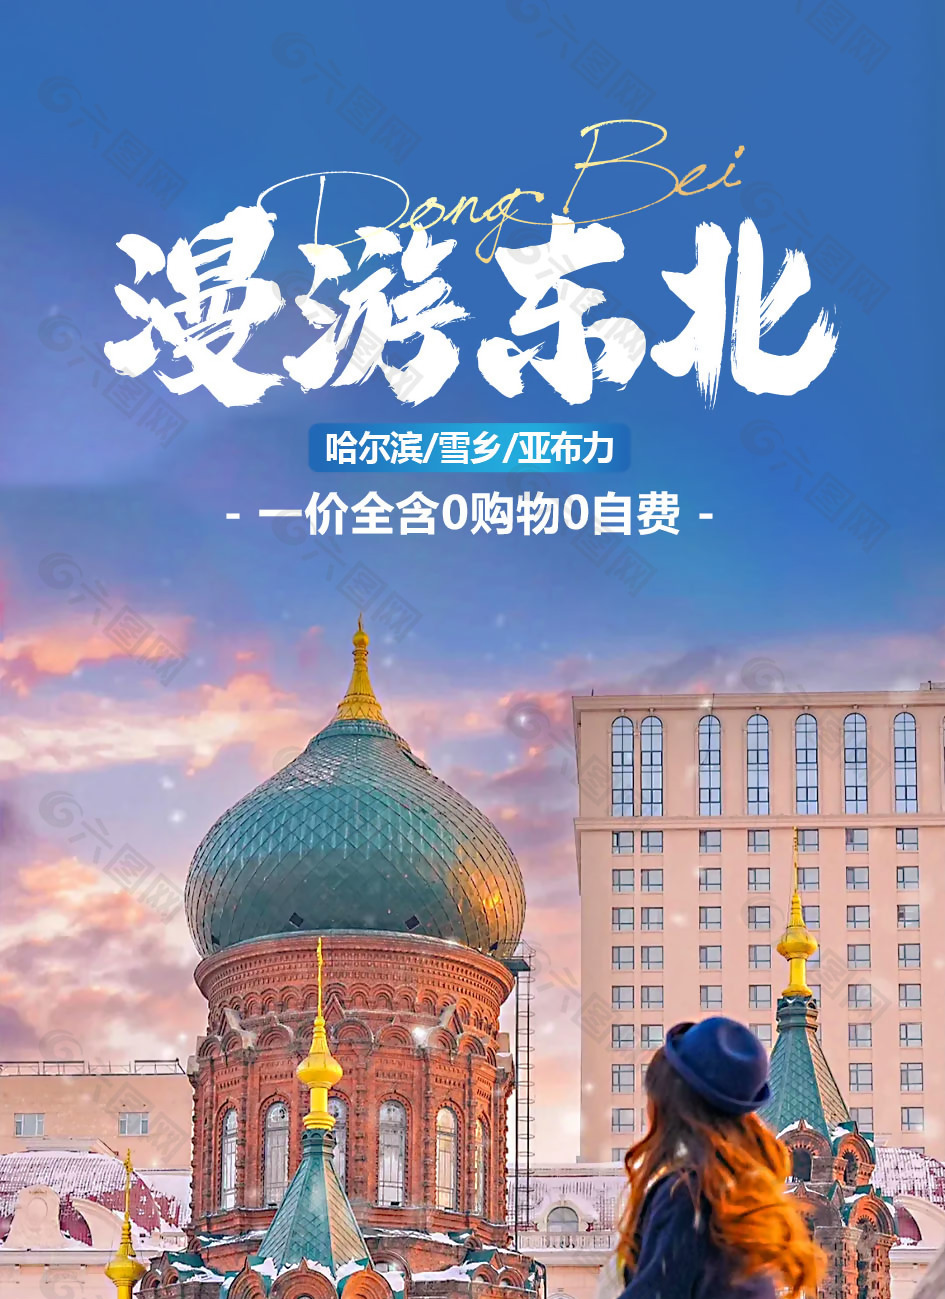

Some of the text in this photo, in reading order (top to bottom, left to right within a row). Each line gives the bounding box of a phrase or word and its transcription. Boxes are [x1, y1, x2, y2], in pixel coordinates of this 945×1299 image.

[563, 119, 746, 220] Bei
[104, 206, 839, 409] 漫游东北
[326, 430, 614, 465] 哈尔滨/雪乡/亚布力
[258, 490, 680, 536] 一价全含0购物0自费
